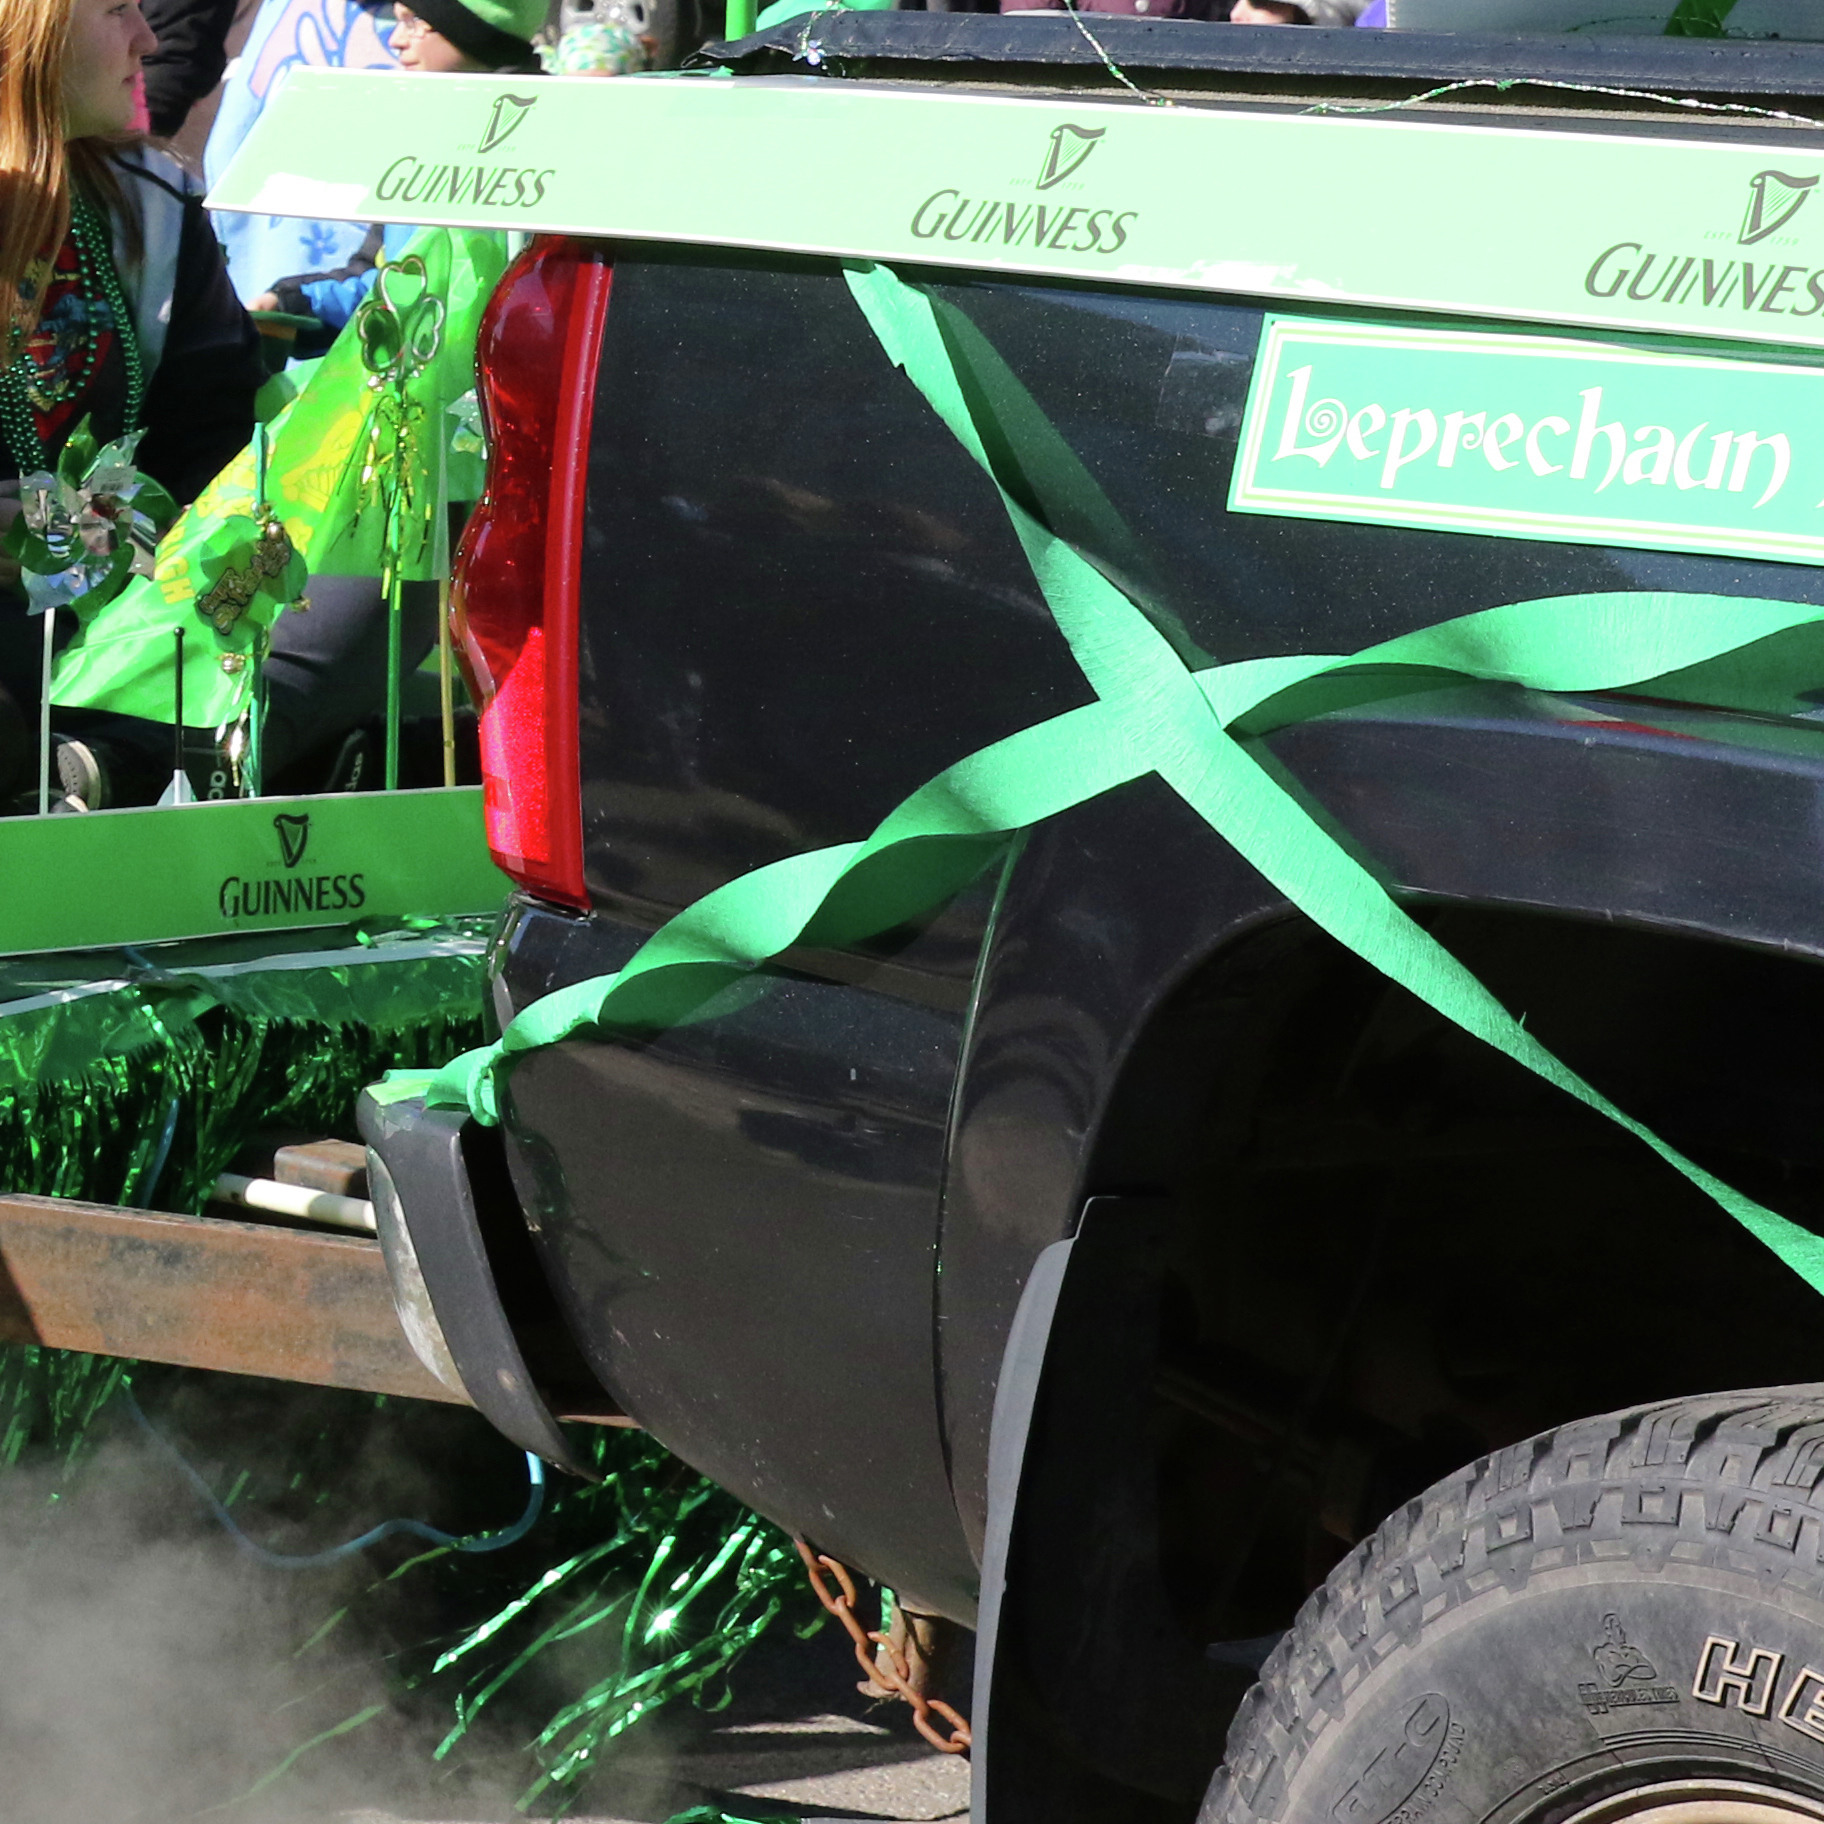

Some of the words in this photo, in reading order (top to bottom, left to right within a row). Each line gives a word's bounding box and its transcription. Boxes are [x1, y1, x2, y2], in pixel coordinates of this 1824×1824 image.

[375, 155, 557, 208] GUINNESS
[910, 188, 1140, 254] GUINNESS
[1584, 240, 1824, 318] GUINNES
[1270, 364, 1792, 510] Leprechaun
[219, 873, 366, 918] GUINNESS
